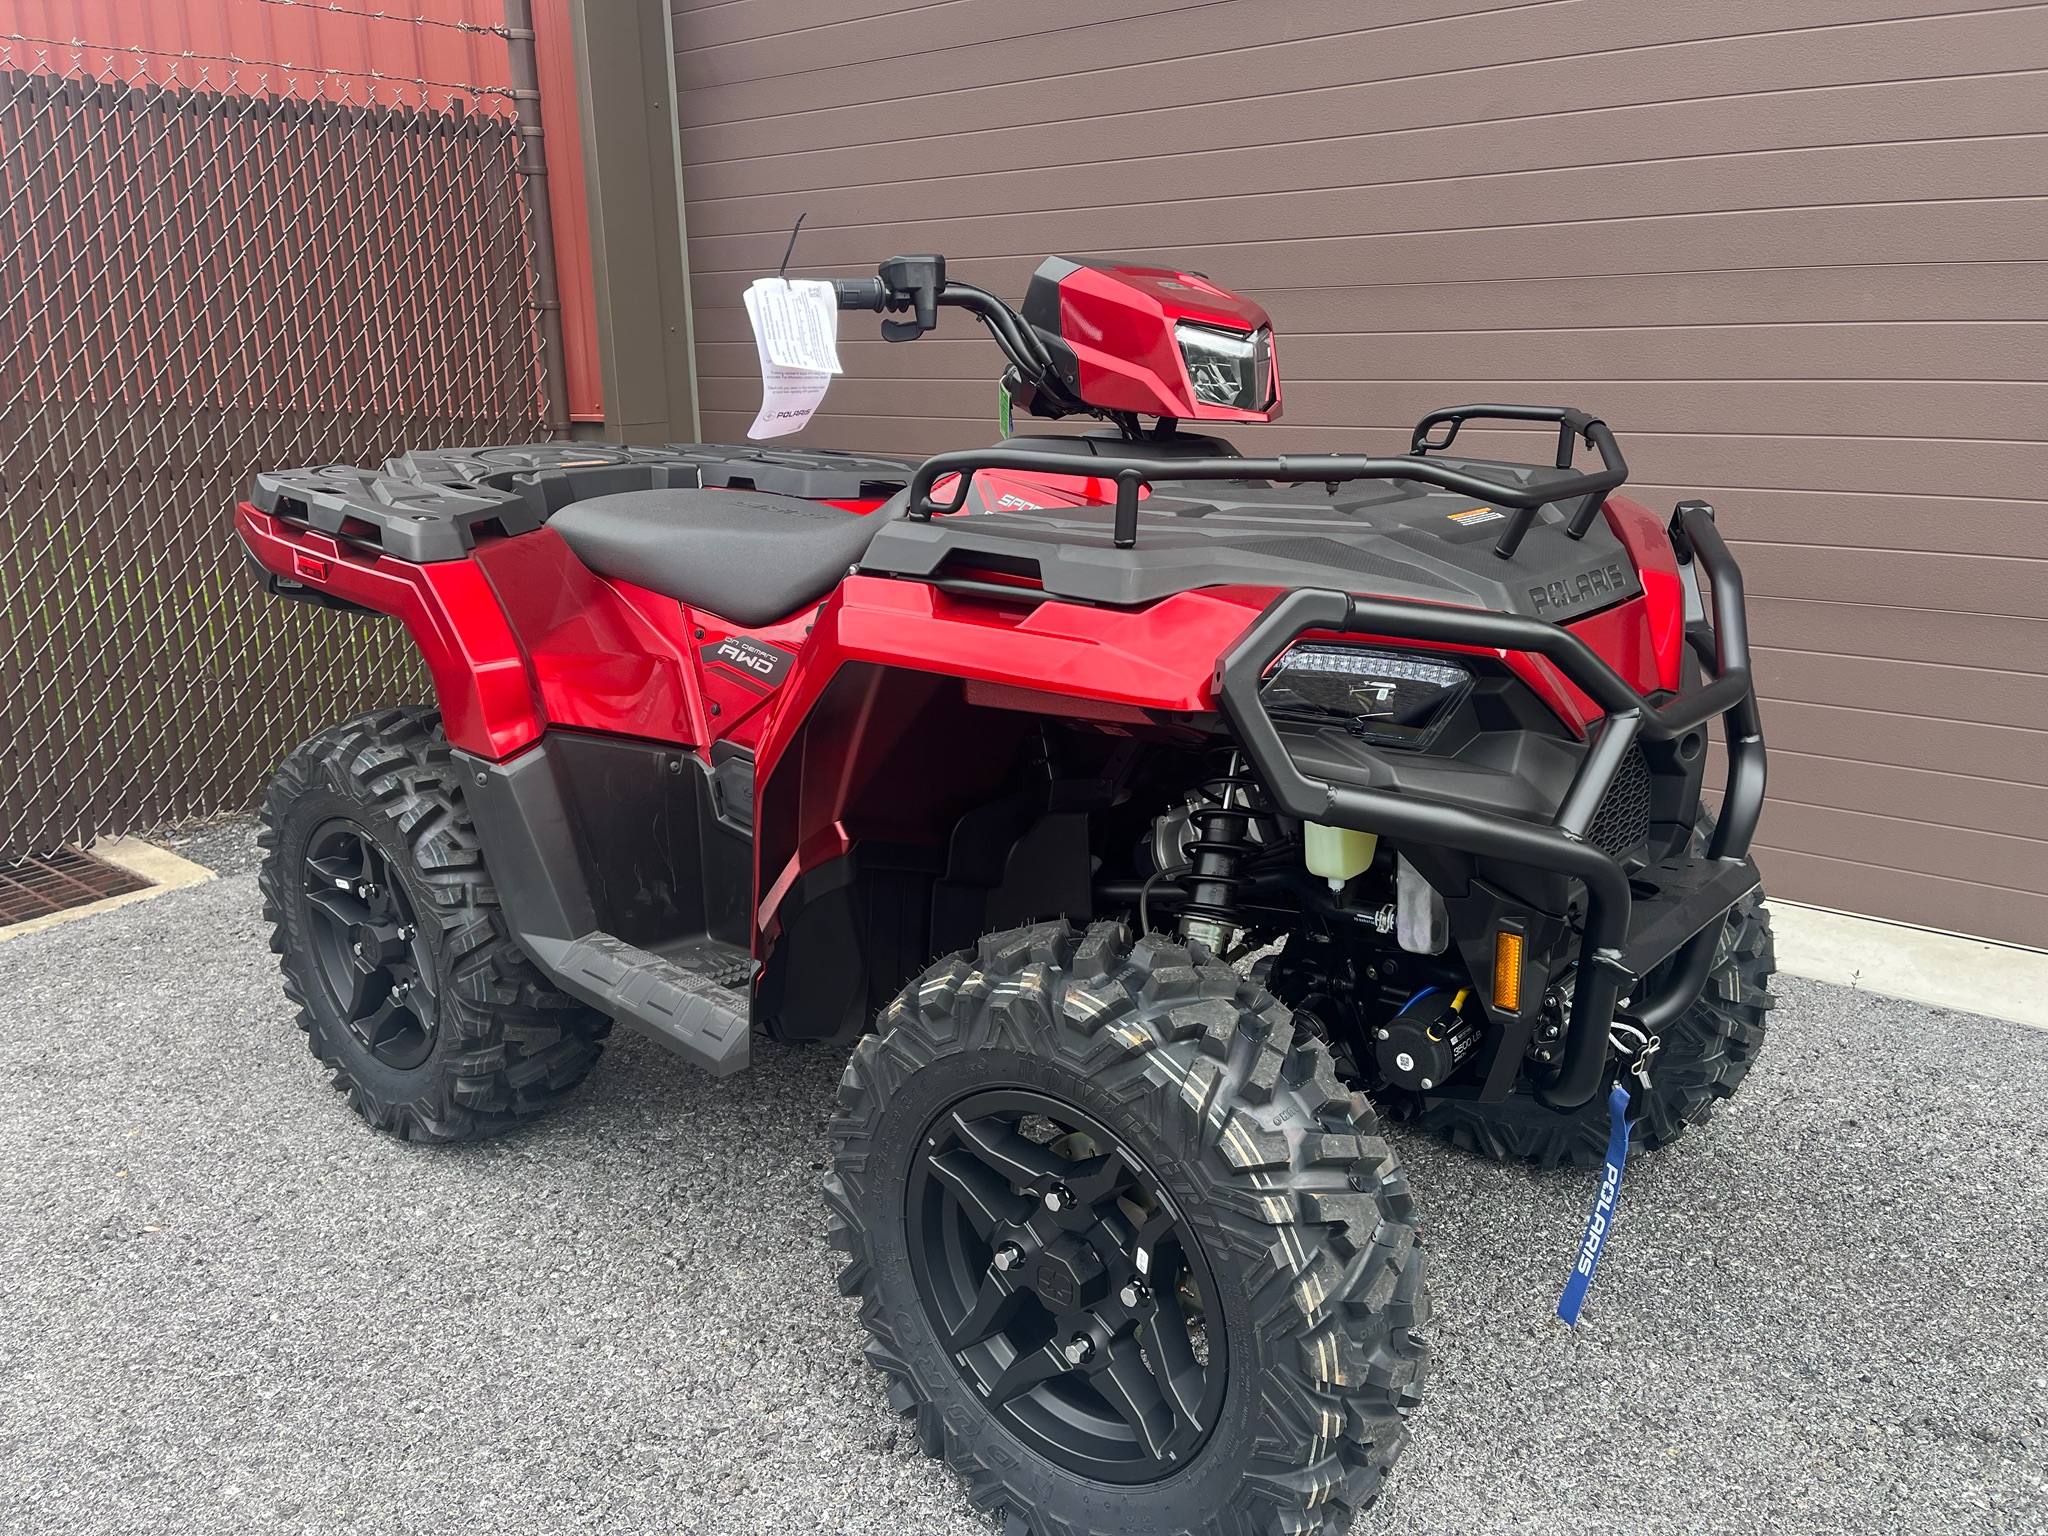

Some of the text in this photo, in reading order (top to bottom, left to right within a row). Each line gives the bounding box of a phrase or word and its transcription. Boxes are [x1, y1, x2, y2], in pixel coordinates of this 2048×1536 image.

[776, 408, 812, 419] POLARIS
[1528, 564, 1626, 614] POLARIS
[717, 643, 774, 674] AWD
[741, 643, 779, 663] DEMAND
[1577, 1161, 1619, 1277] POLARIS
